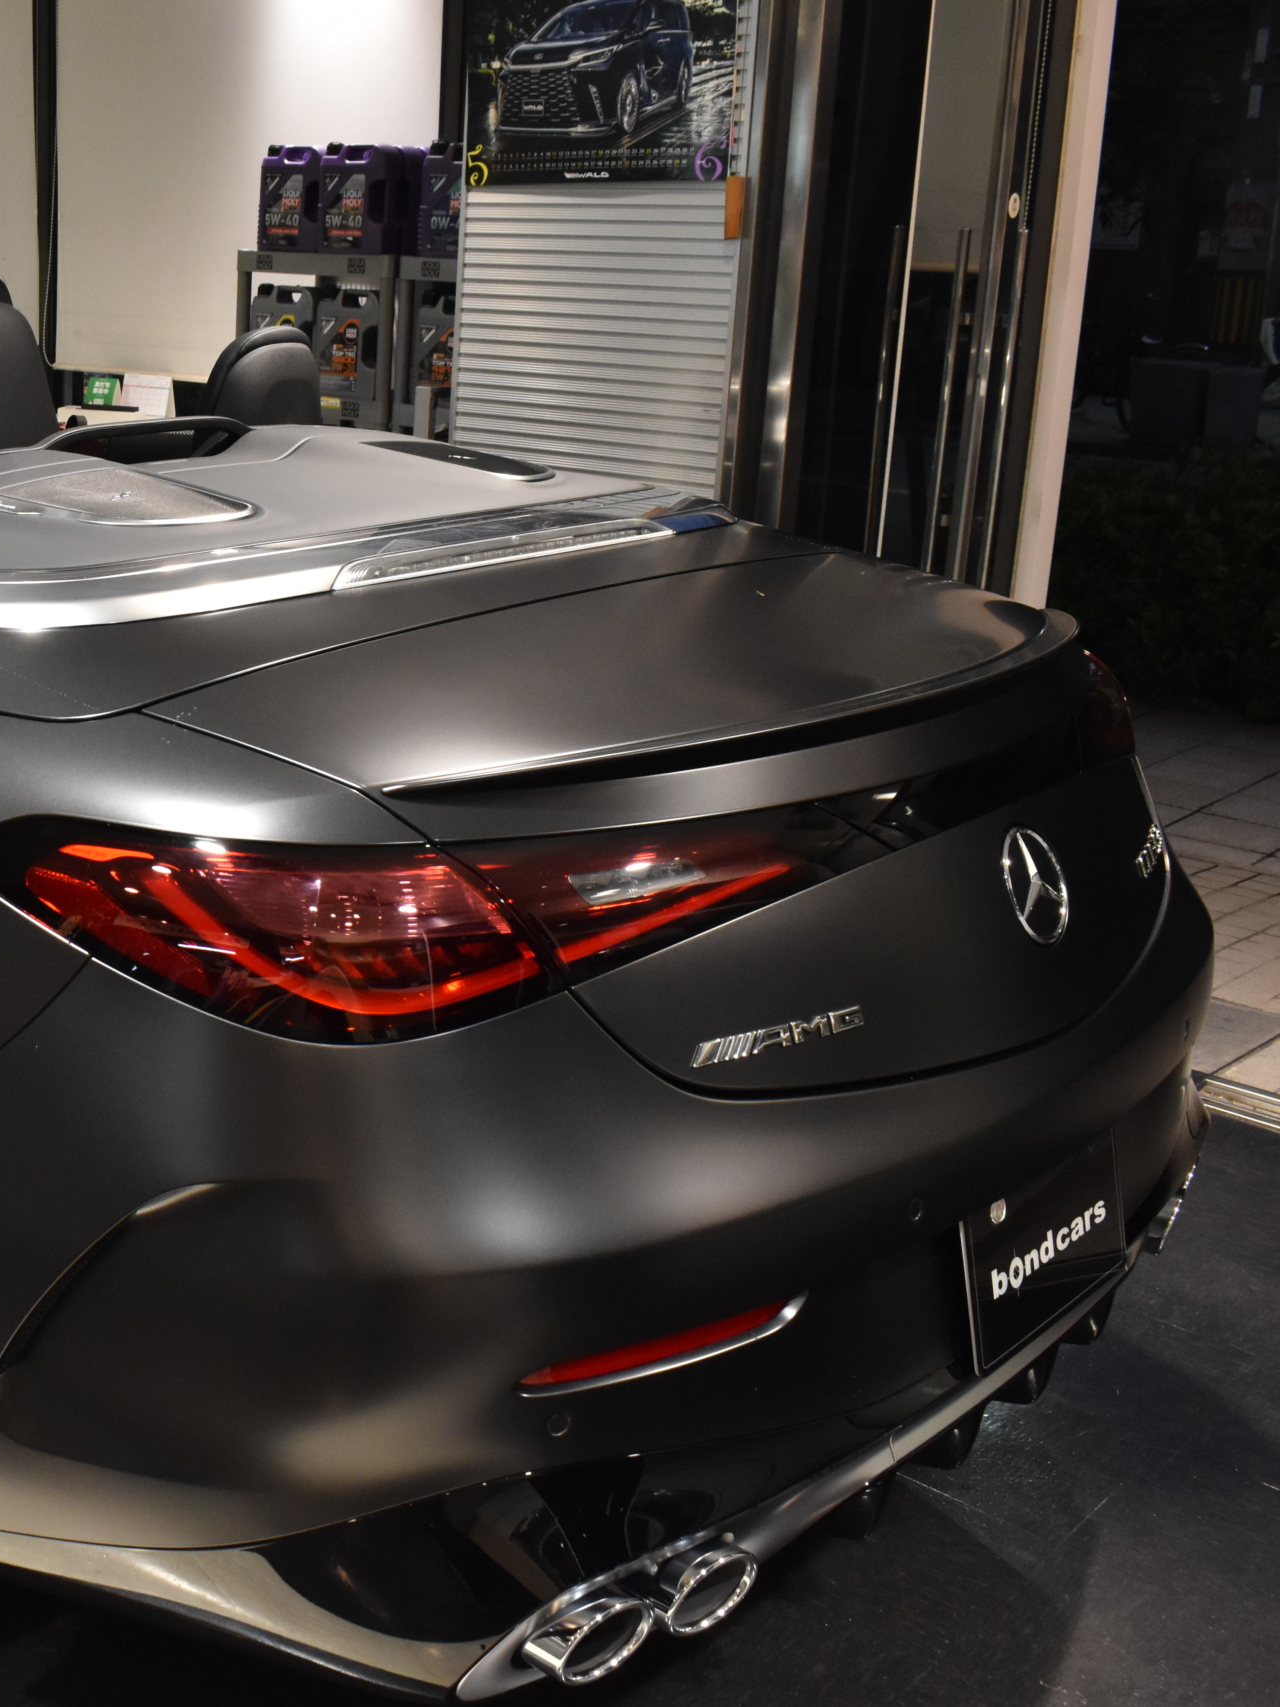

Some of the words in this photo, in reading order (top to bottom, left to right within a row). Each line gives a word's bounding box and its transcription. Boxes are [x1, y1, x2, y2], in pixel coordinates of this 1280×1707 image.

[695, 135, 726, 181] 6
[467, 144, 489, 186] 5
[283, 198, 300, 206] MOLY
[265, 214, 299, 226] 5W-40
[325, 215, 362, 227] 5W-40
[431, 217, 460, 229] 0W-4
